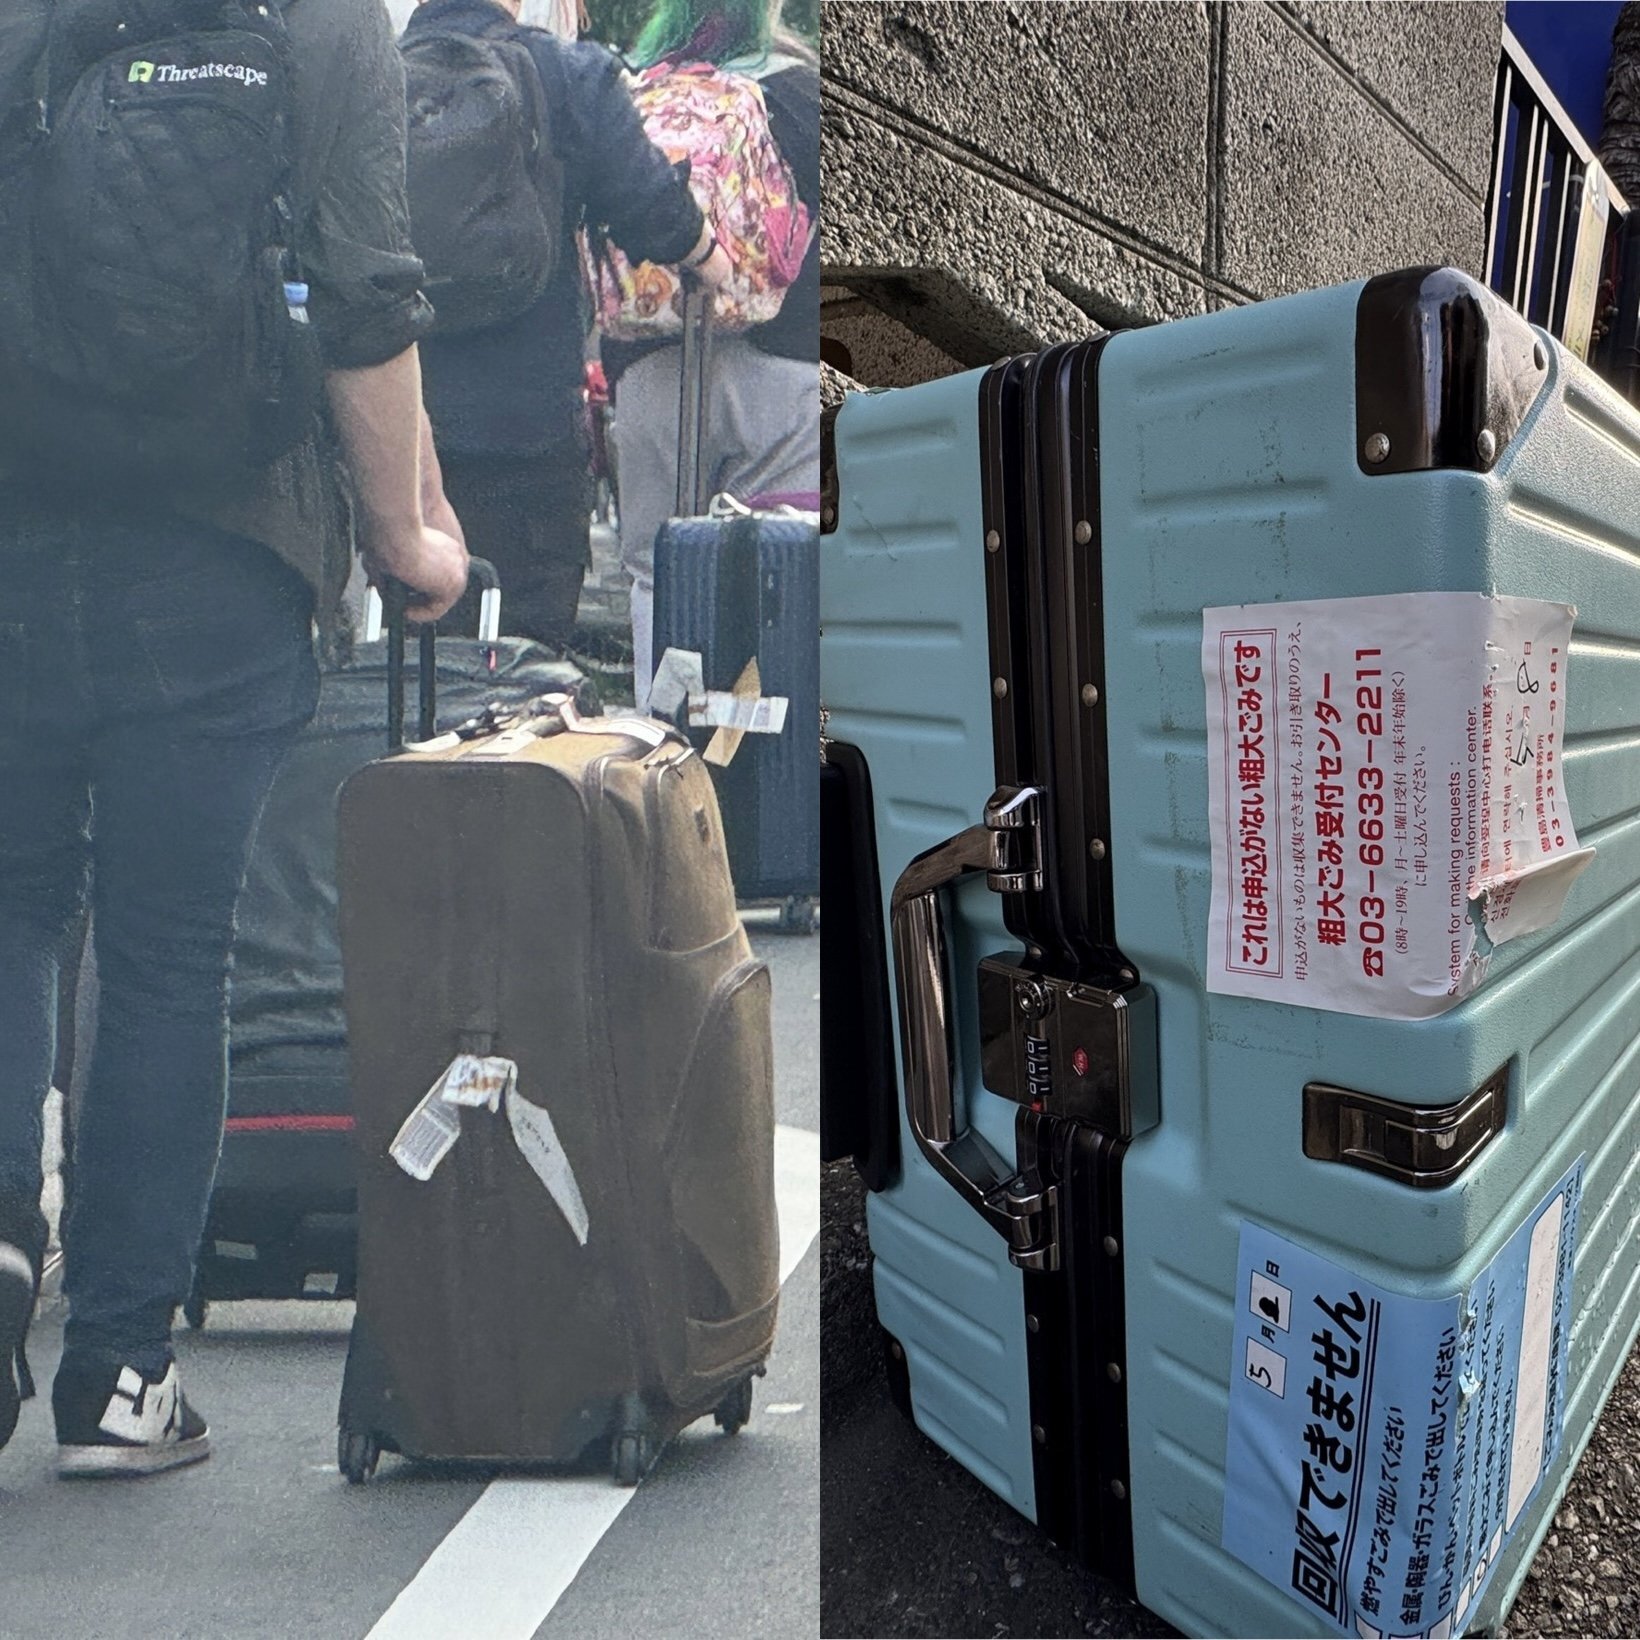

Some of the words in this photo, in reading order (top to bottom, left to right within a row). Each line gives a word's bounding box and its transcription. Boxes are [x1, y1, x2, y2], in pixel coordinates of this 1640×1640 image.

[157, 63, 268, 86] Threatscape
[1517, 659, 1539, 694] 8
[1524, 641, 1532, 655] 日
[1465, 706, 1477, 763] center.
[1234, 640, 1268, 965] これは申込がない粗大ごみです
[1288, 622, 1308, 980] 申込がないものは収集できません。お引き取りのうえ、
[1315, 673, 1346, 946] 粗大ごみ受付センター
[1413, 745, 1428, 887] に申し込んでください。
[1448, 769, 1463, 846] requests
[1465, 766, 1477, 865] information
[1448, 849, 1464, 910] making
[1448, 913, 1461, 941] for
[1266, 1260, 1280, 1278] 日
[1261, 1324, 1276, 1344] 月
[1249, 1363, 1272, 1388] 5
[1292, 1291, 1367, 1619] 回収できません
[1400, 1327, 1456, 1626] 金属・陶器・ガラスごみで出してください
[1360, 1406, 1405, 1617] 燃やすごみで出してください
